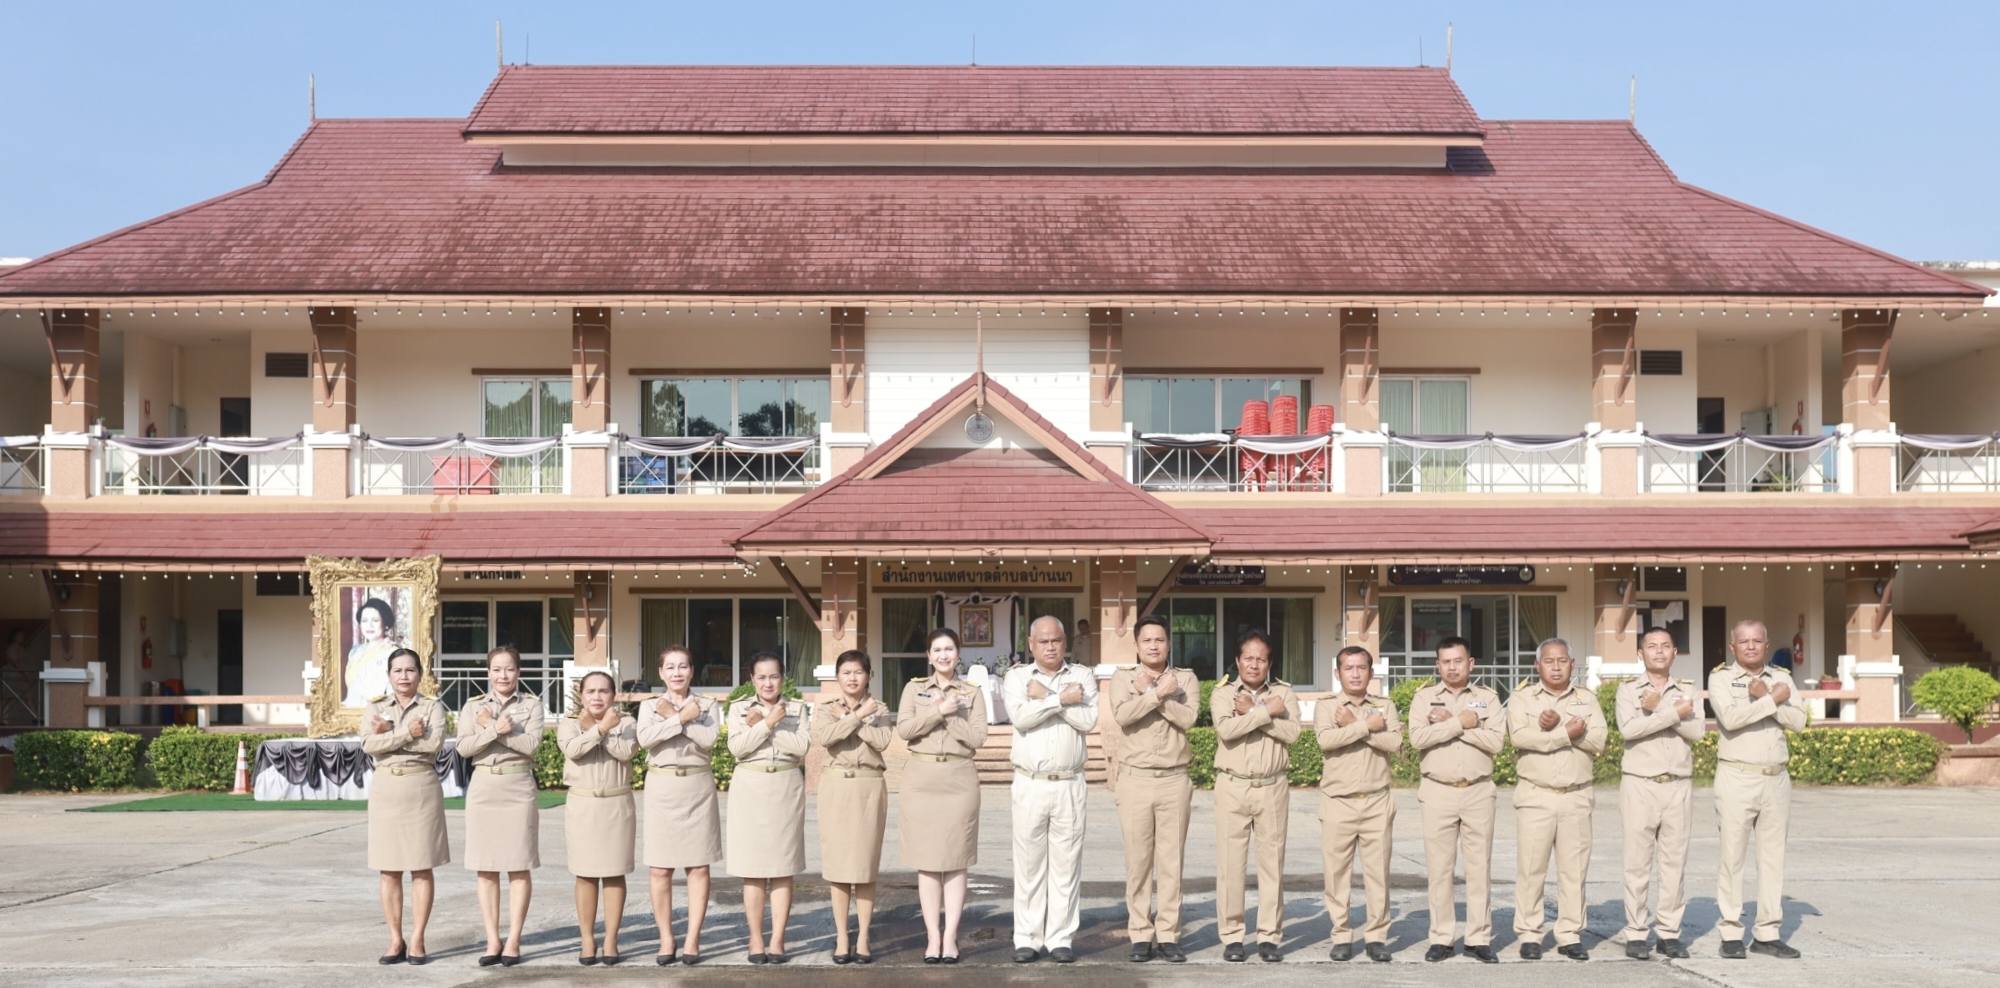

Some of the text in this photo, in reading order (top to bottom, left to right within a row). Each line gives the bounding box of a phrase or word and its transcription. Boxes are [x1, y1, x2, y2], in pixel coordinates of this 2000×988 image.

[881, 566, 1073, 583] สำนักงานเทศบาลตำบลบ้านนา
